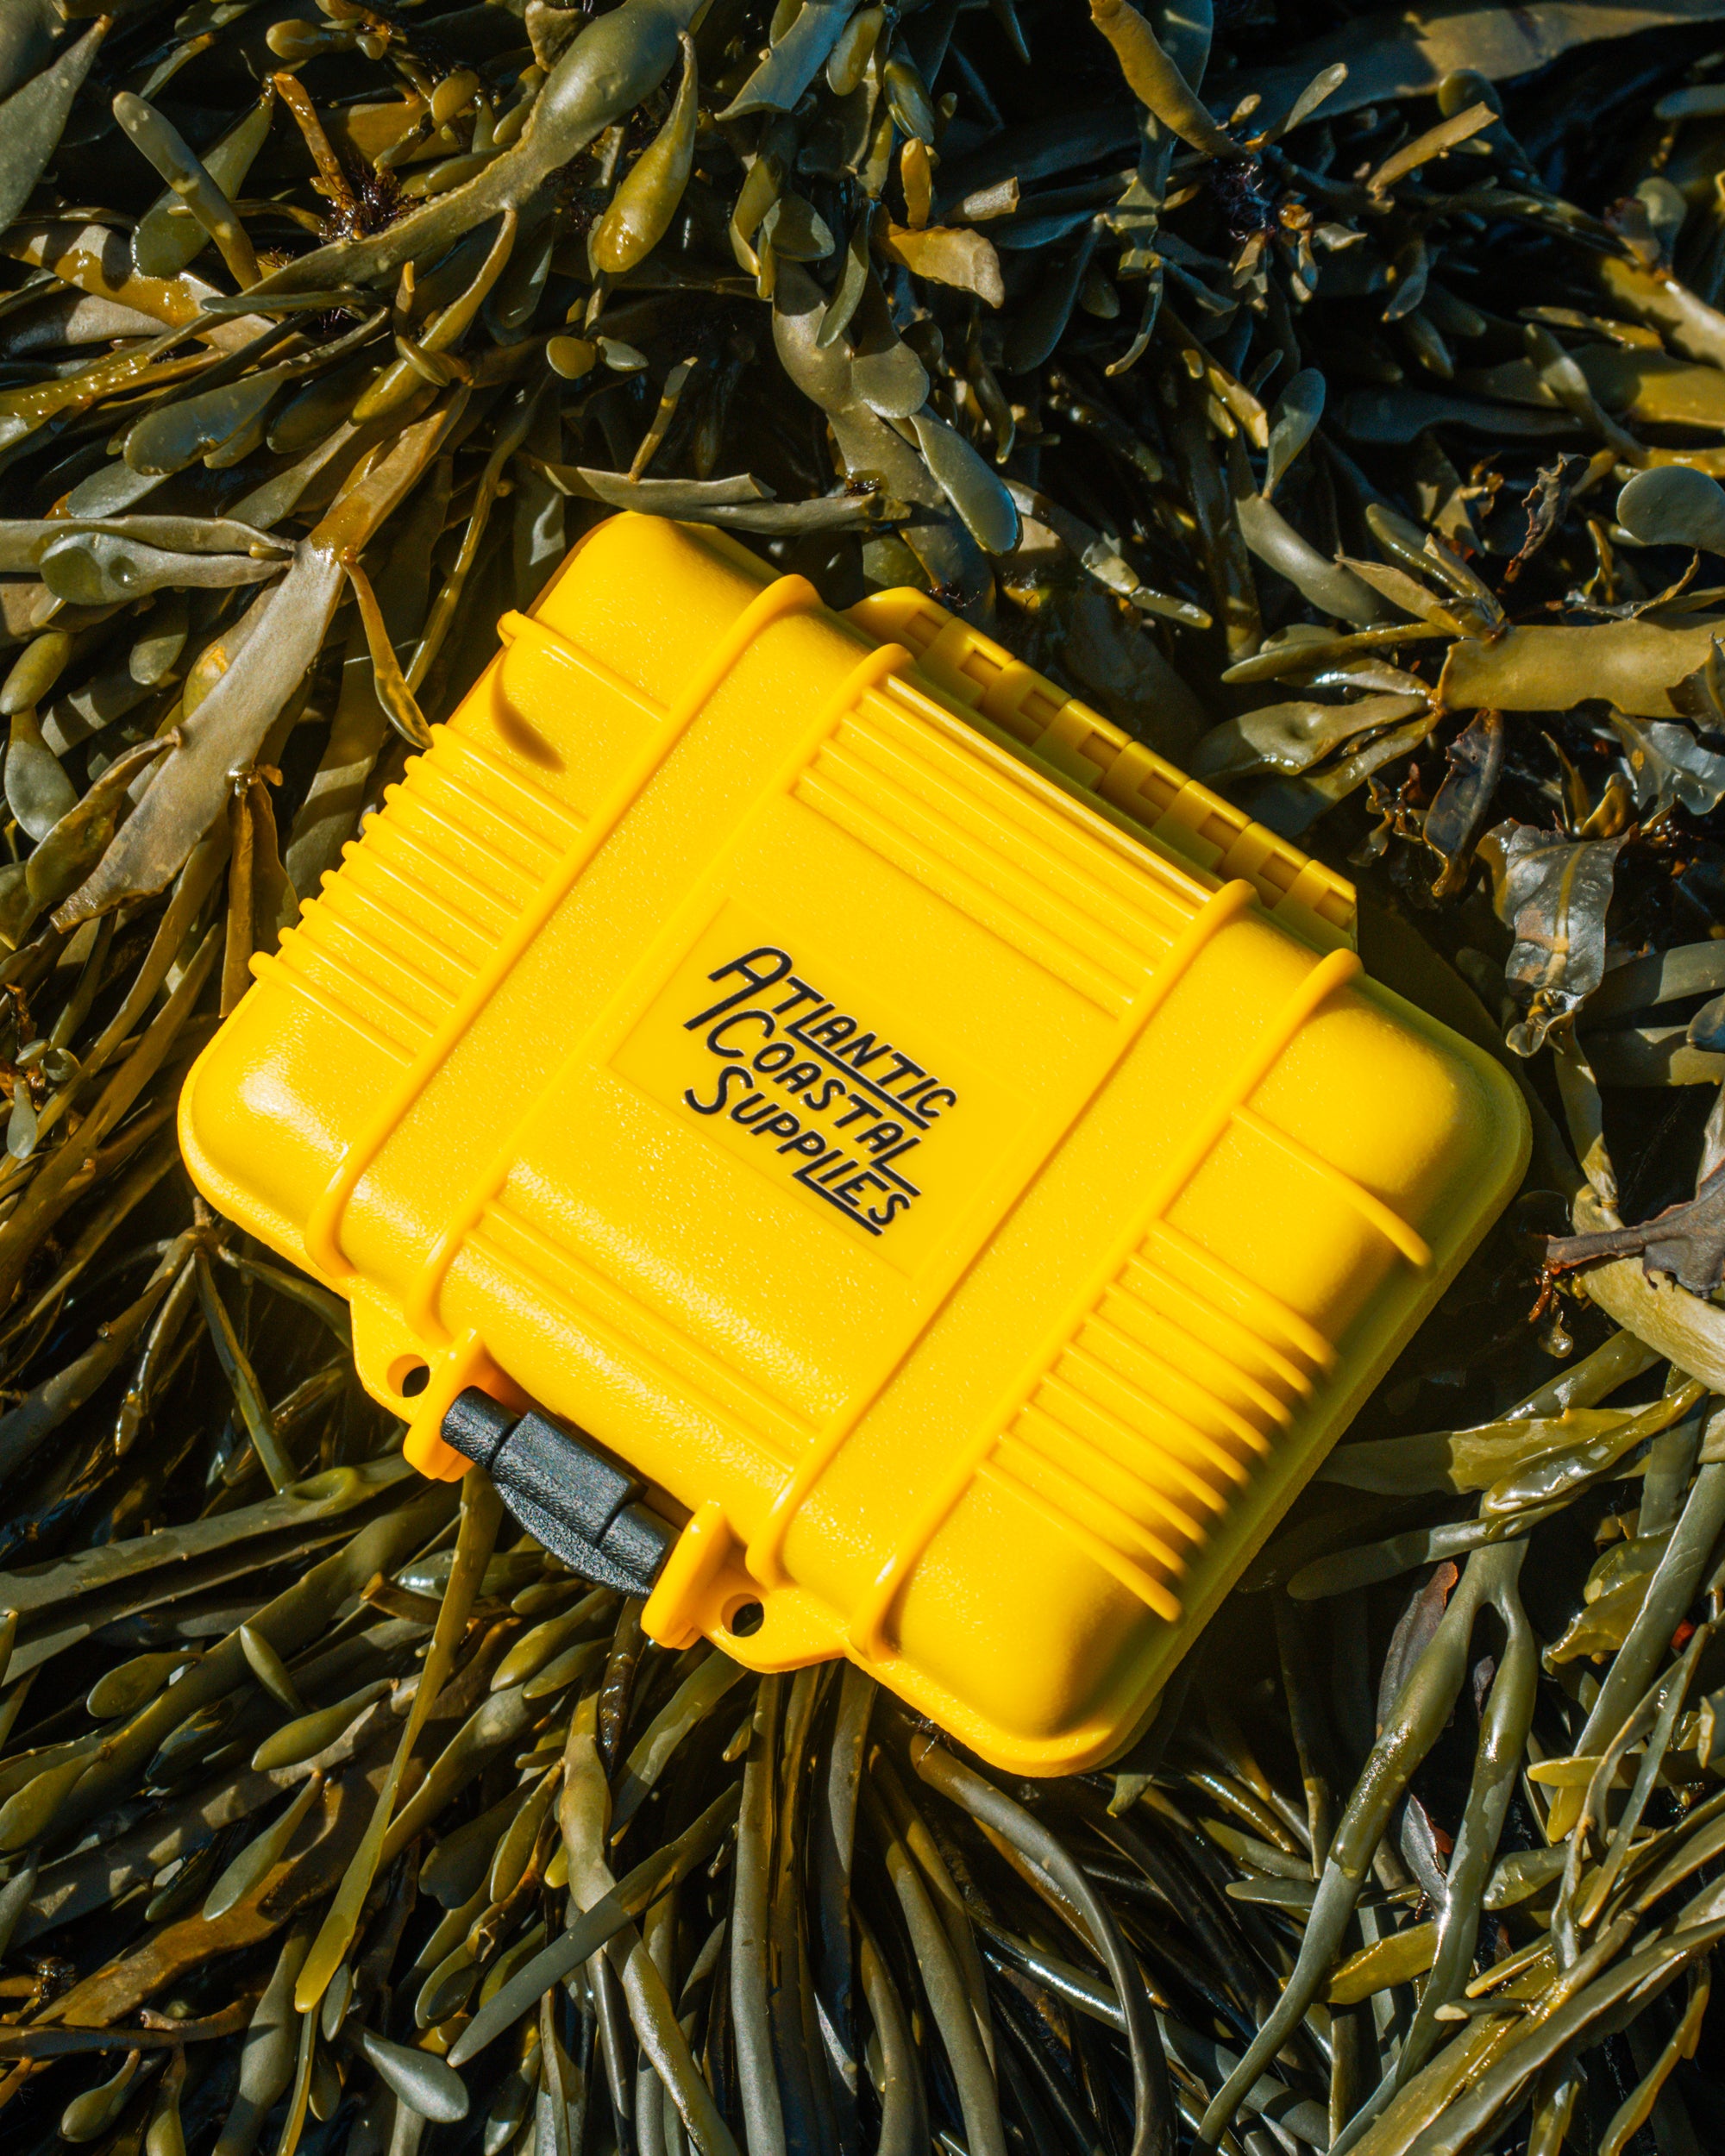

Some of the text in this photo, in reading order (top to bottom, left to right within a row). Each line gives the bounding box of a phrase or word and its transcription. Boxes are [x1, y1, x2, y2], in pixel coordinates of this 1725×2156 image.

[683, 946, 957, 1131] ATLANTIC
[706, 1009, 922, 1198] COASTAL
[684, 1065, 912, 1237] SUPPLIES
